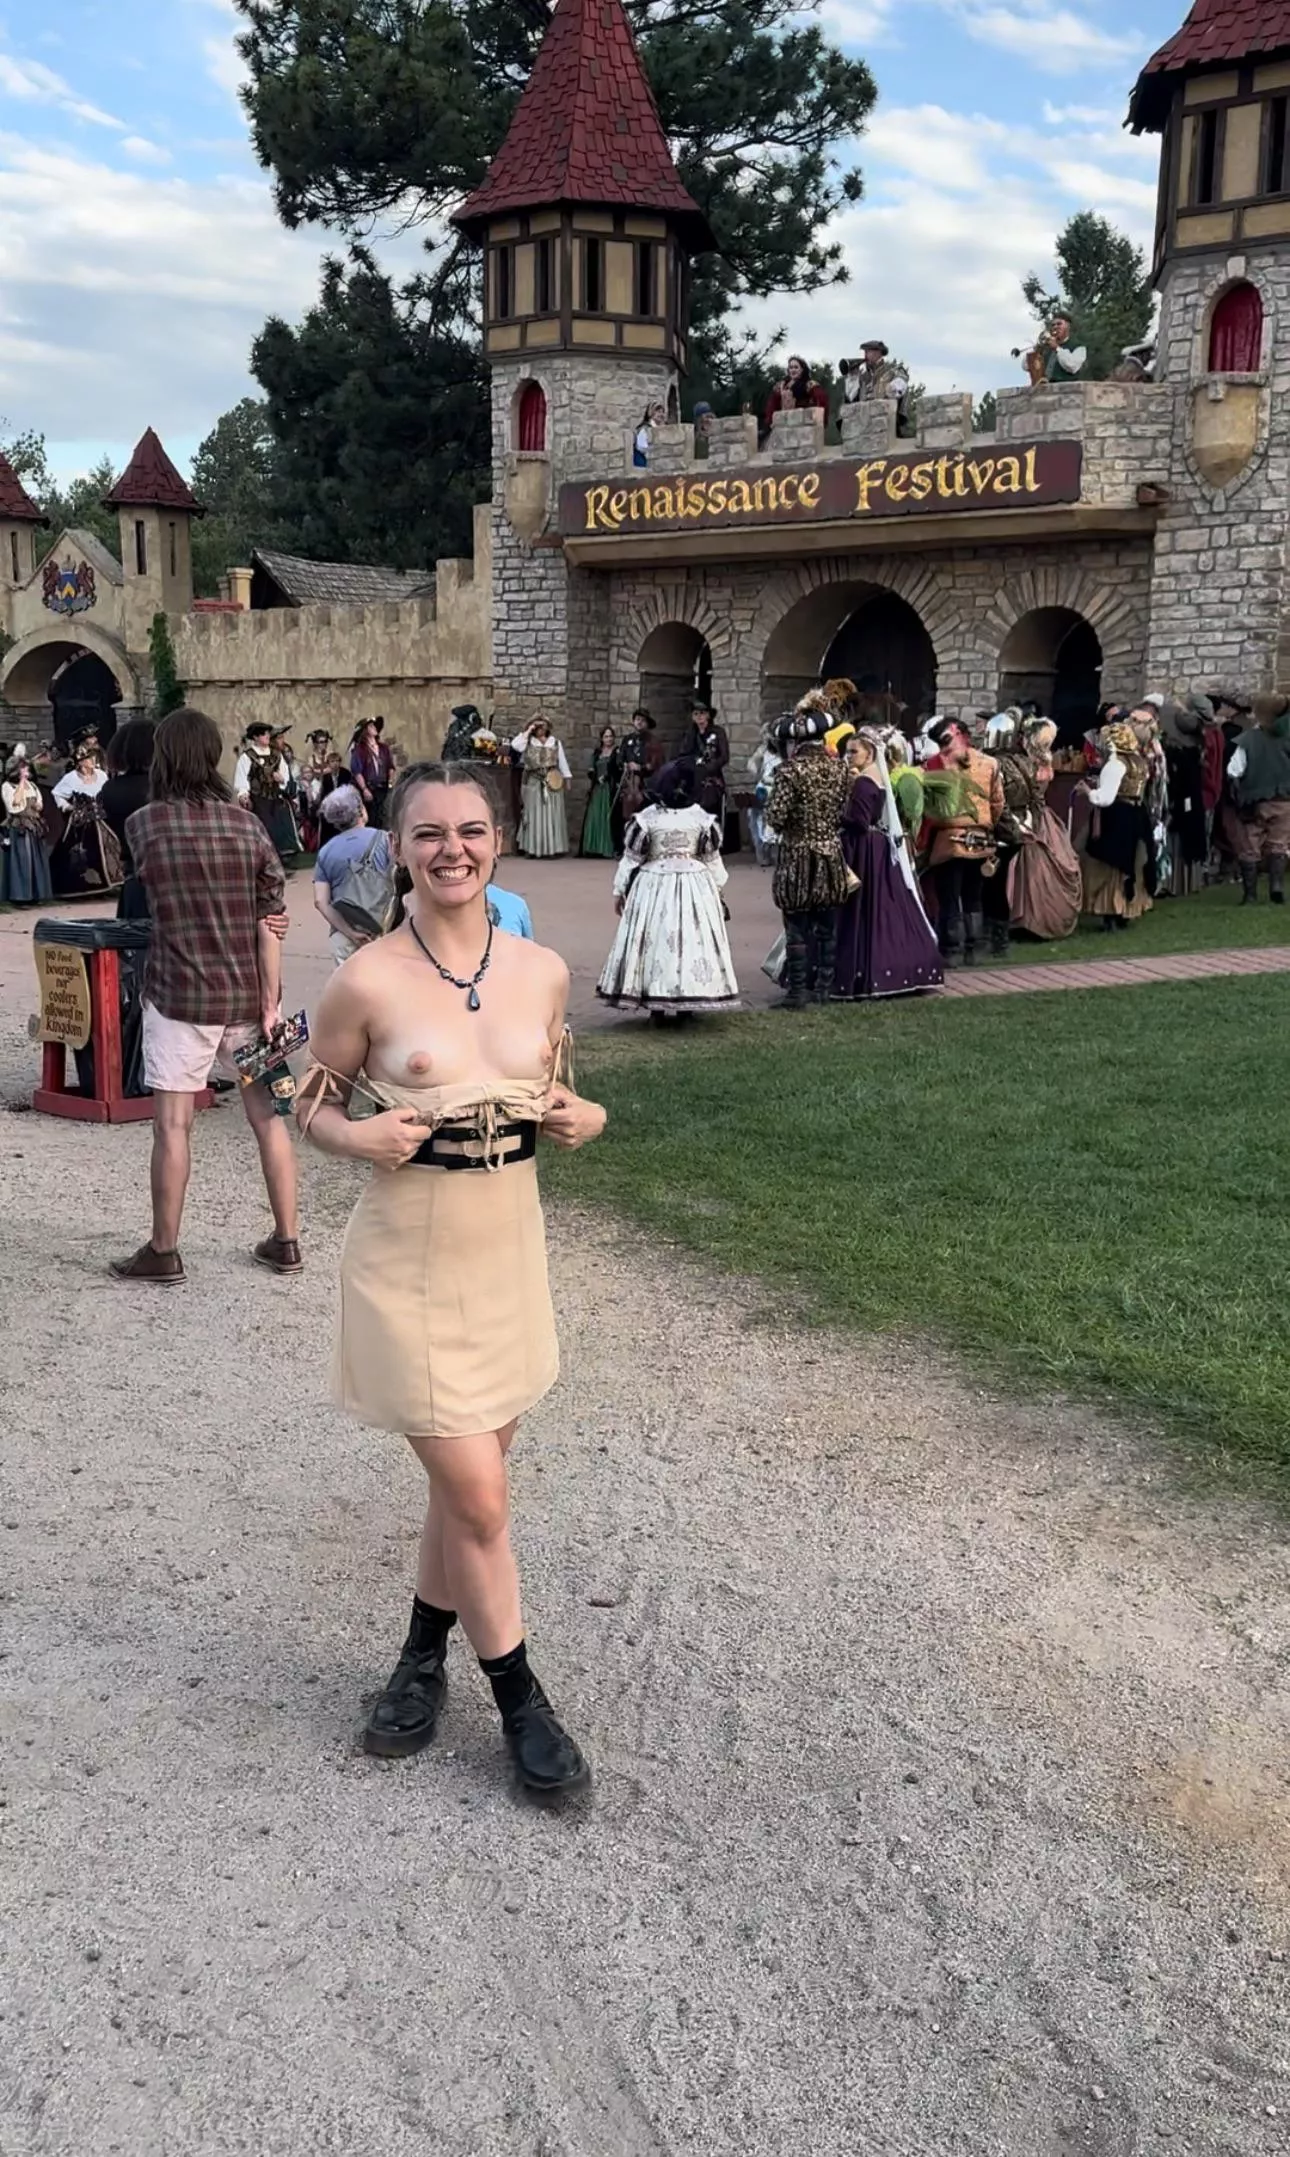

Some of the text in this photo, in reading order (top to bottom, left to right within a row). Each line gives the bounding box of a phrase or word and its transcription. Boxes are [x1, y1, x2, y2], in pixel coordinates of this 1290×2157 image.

[584, 446, 1041, 530] Renaissance Festival
[55, 977, 70, 989] nor
[48, 990, 78, 1006] coolers
[44, 1003, 84, 1022] allowed in
